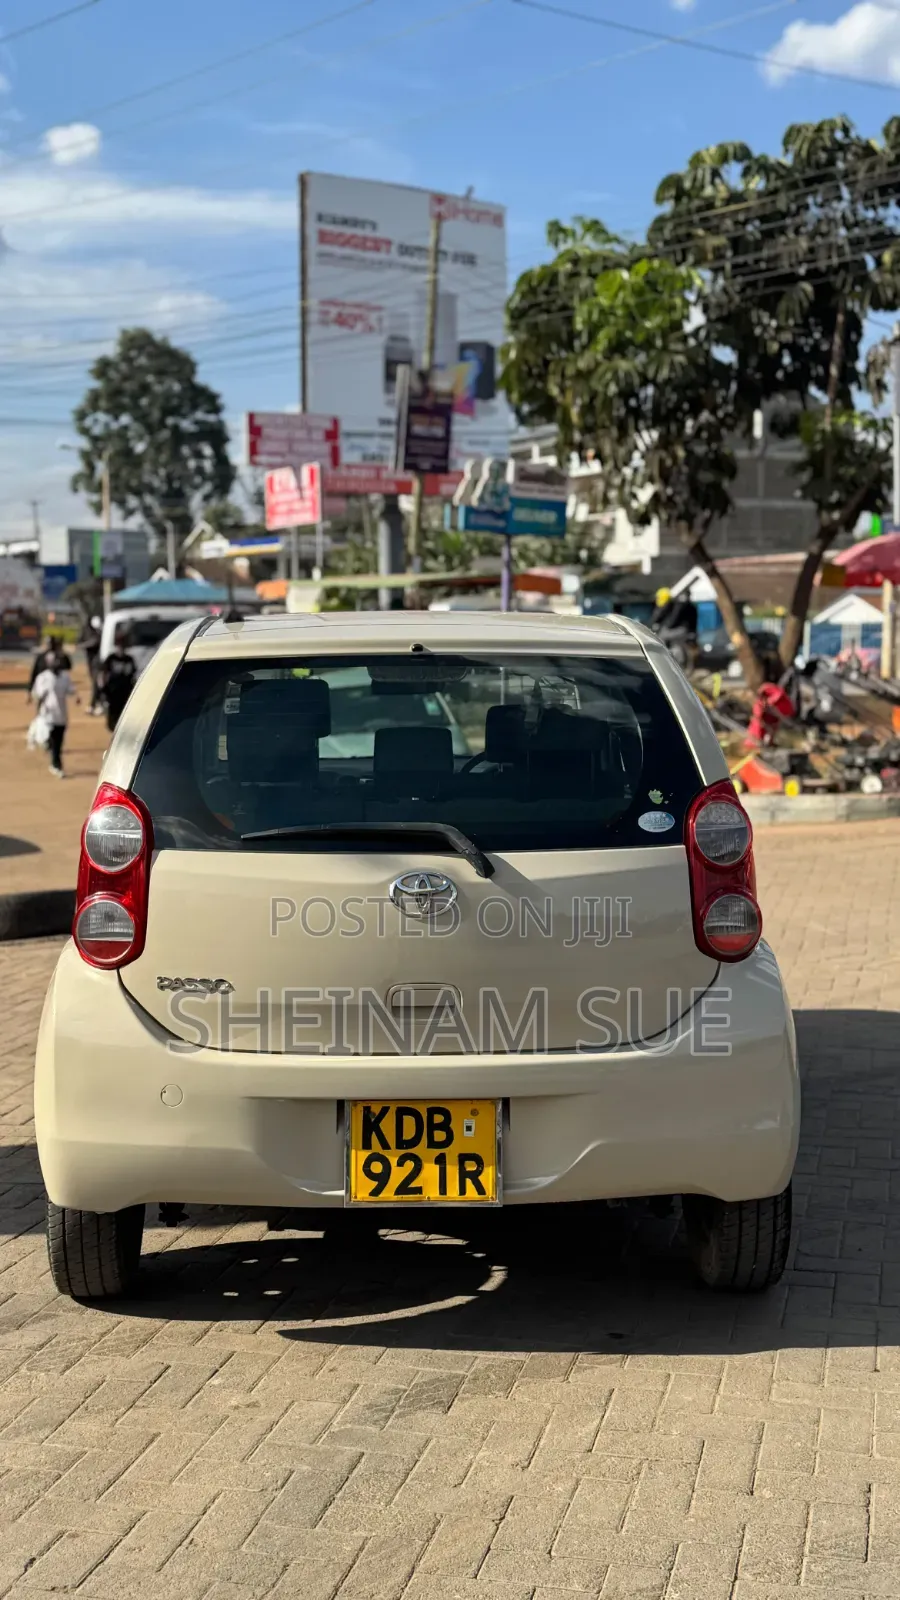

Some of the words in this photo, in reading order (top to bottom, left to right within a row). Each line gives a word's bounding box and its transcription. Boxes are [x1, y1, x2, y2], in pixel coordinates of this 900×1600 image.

[318, 229, 392, 255] BIGGEST
[362, 1106, 454, 1150] KDB
[362, 1152, 487, 1197] 921R
